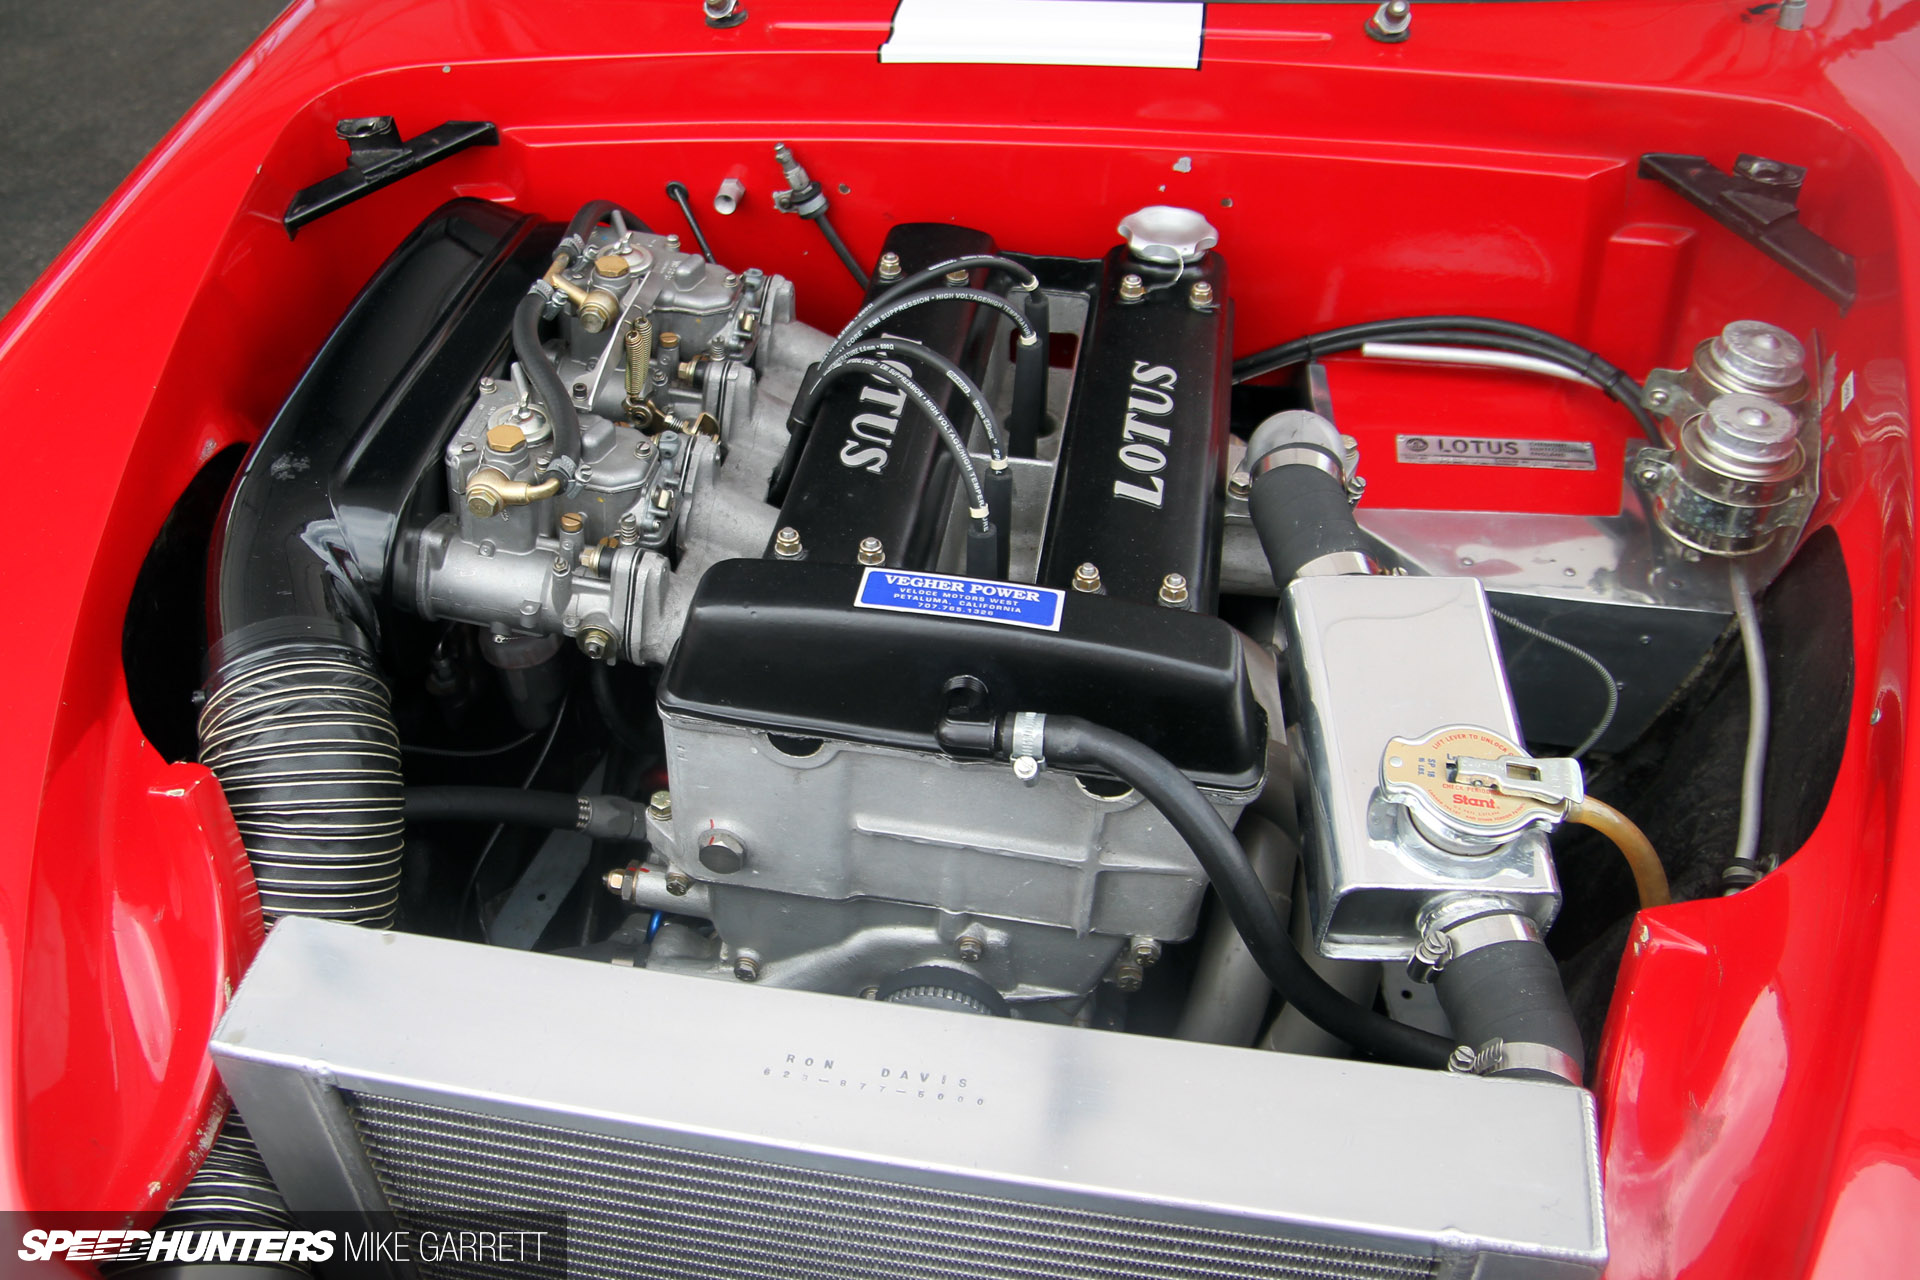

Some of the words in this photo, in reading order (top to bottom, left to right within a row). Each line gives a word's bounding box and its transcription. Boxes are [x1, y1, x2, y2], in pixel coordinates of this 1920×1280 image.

[846, 329, 863, 347] CORE
[867, 317, 881, 328] EMI
[880, 295, 930, 321] SUPPRESSION
[936, 292, 954, 301] HIGH
[888, 368, 925, 398] SUPPRESSION
[924, 399, 941, 416] HIGH
[1114, 360, 1178, 509] LOTUS
[1438, 439, 1519, 456] LOTUS
[884, 574, 965, 593] VEGHER
[969, 583, 1040, 603] POWER
[899, 587, 938, 597] VELOCE
[942, 592, 985, 603] MOTORS
[989, 598, 1019, 607] WEST
[893, 593, 953, 606] PETALUMA,
[958, 600, 1022, 614] CALIFORNIA
[1433, 739, 1446, 750] LIFT
[1445, 733, 1467, 743] LEVER
[1480, 736, 1507, 752] UNLOCK
[1427, 758, 1437, 768] SP
[1442, 783, 1464, 792] CHECK
[1453, 794, 1495, 809] Stant
[786, 1053, 835, 1071] RON
[880, 1067, 968, 1088] DAVIS
